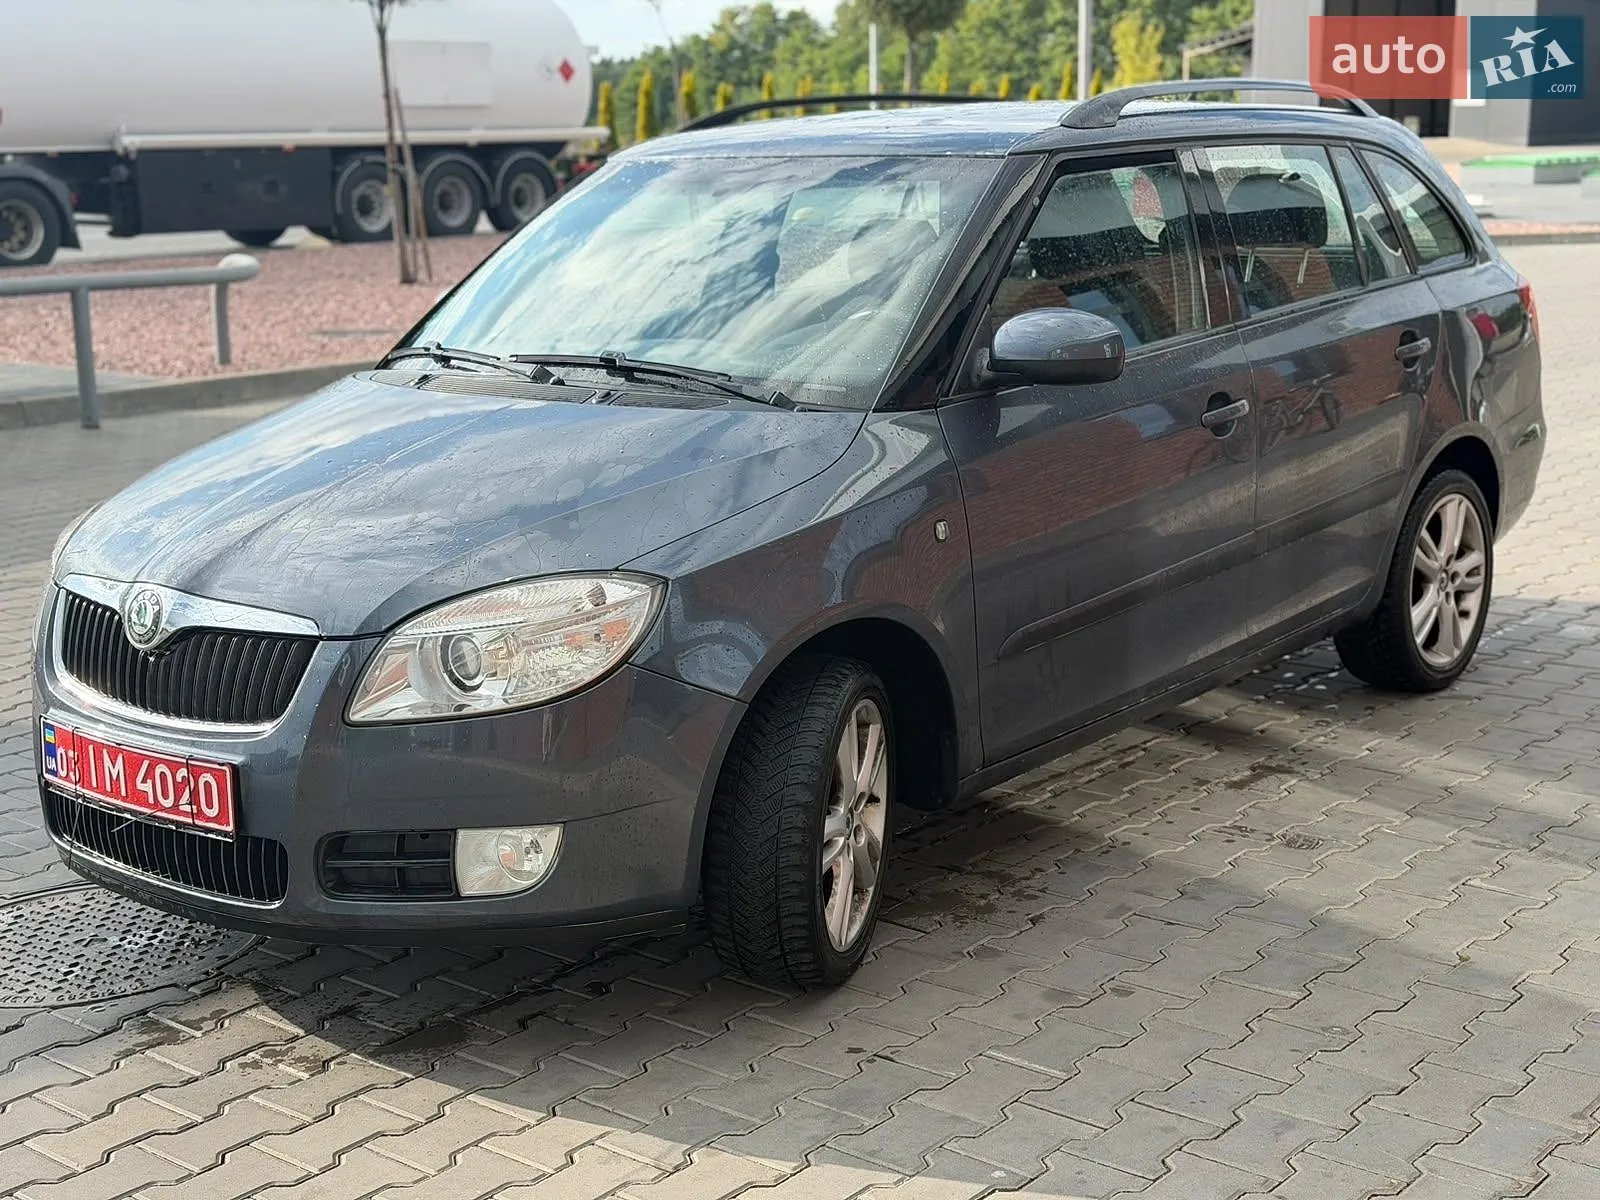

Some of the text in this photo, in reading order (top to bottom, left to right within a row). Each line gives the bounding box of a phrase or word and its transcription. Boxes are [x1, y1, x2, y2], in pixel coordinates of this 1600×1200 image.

[46, 755, 57, 771] UA
[88, 744, 127, 797] IM
[135, 759, 220, 818] 4020
